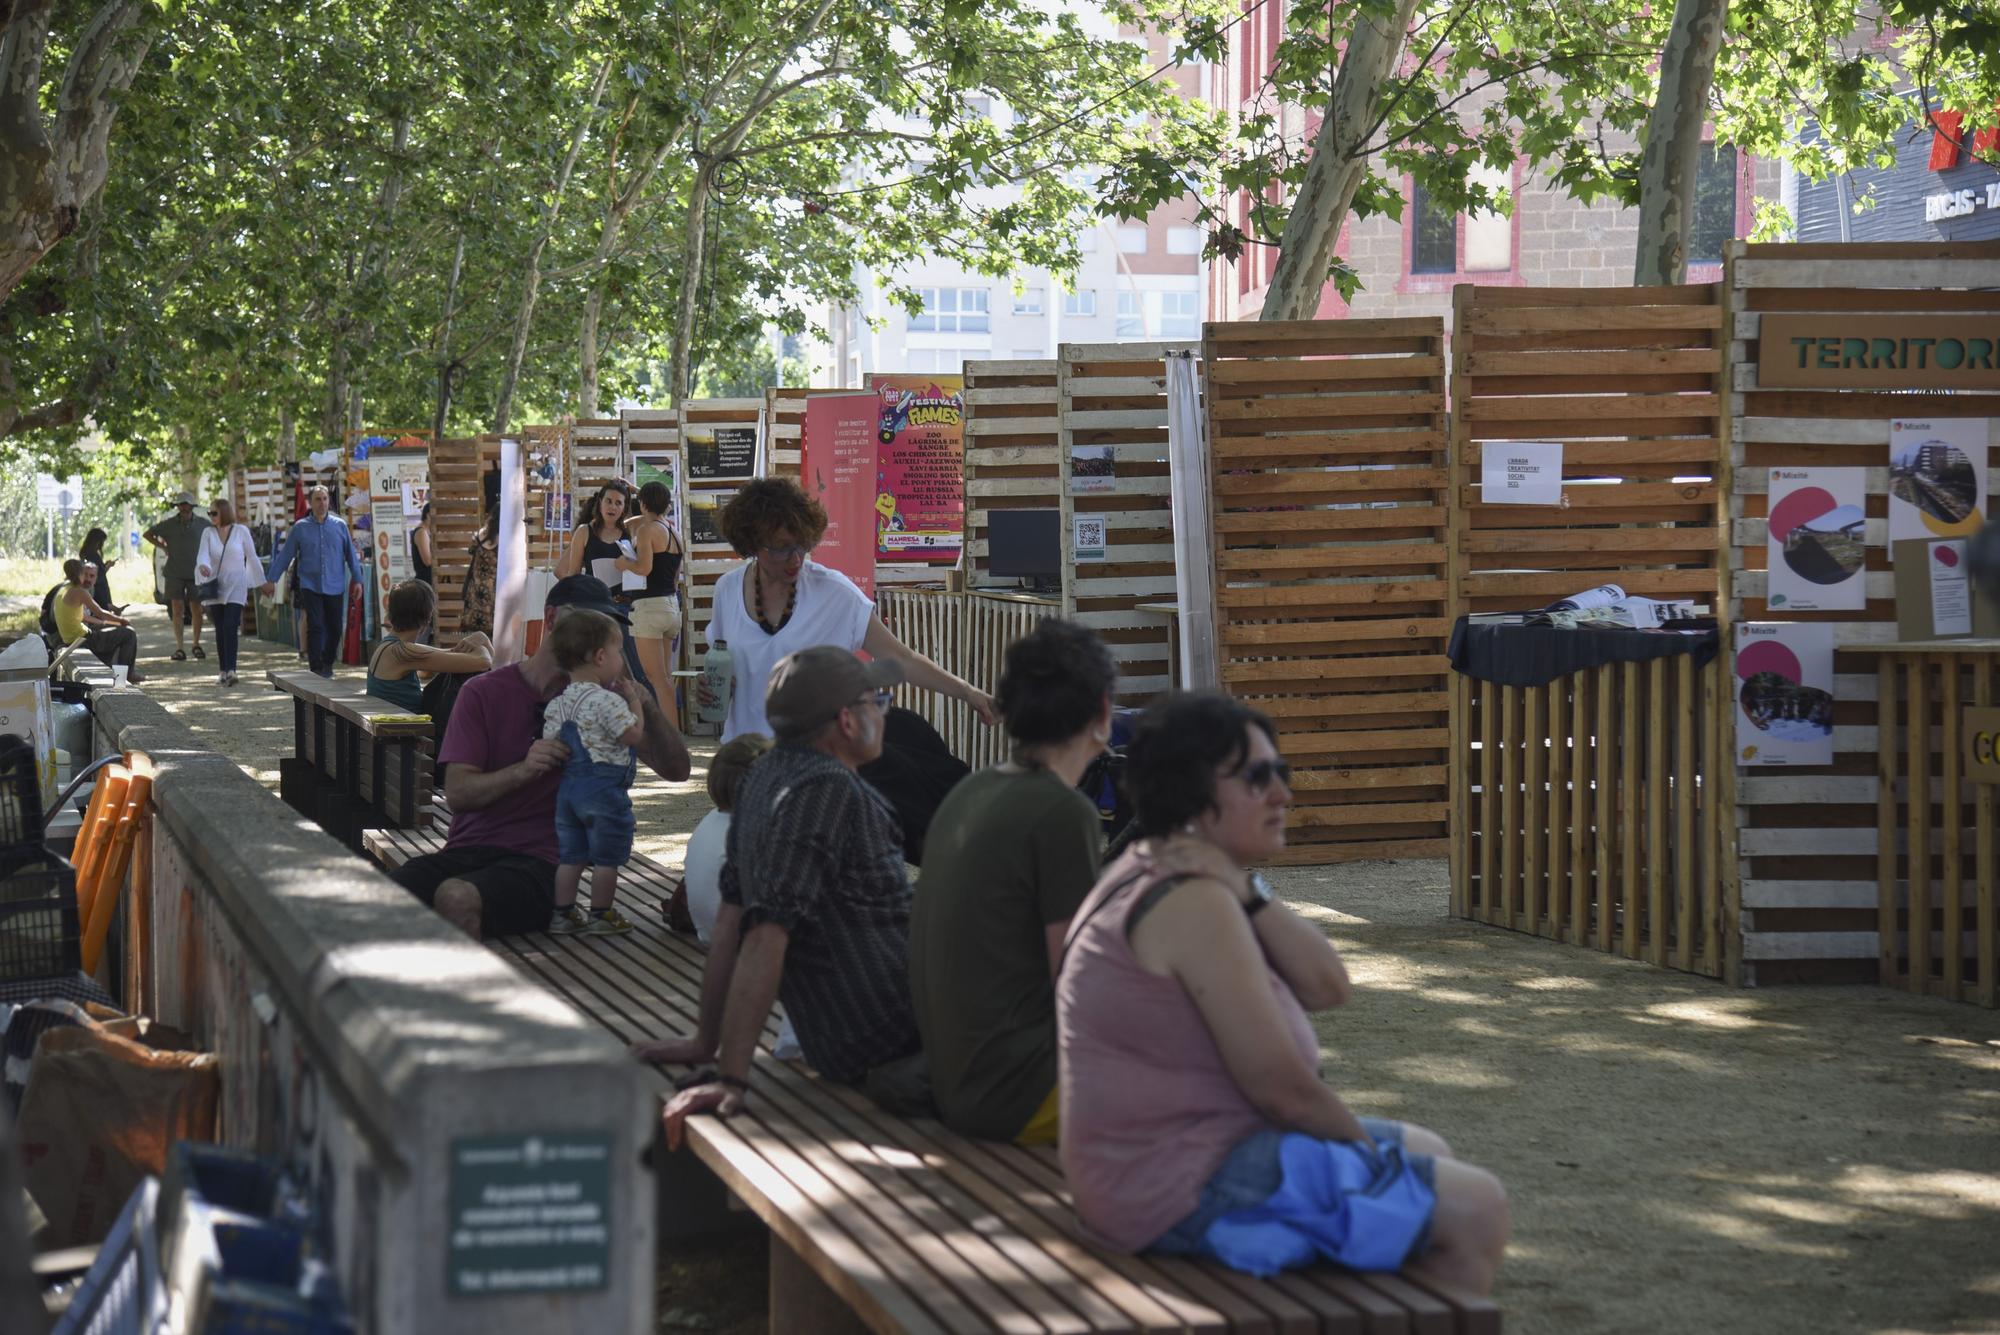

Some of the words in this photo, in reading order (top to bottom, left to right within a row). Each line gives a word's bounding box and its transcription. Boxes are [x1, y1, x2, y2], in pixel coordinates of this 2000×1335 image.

[909, 398, 958, 406] FESTIVAL
[908, 406, 960, 425] FLAMES
[1782, 471, 1808, 479] Mixité
